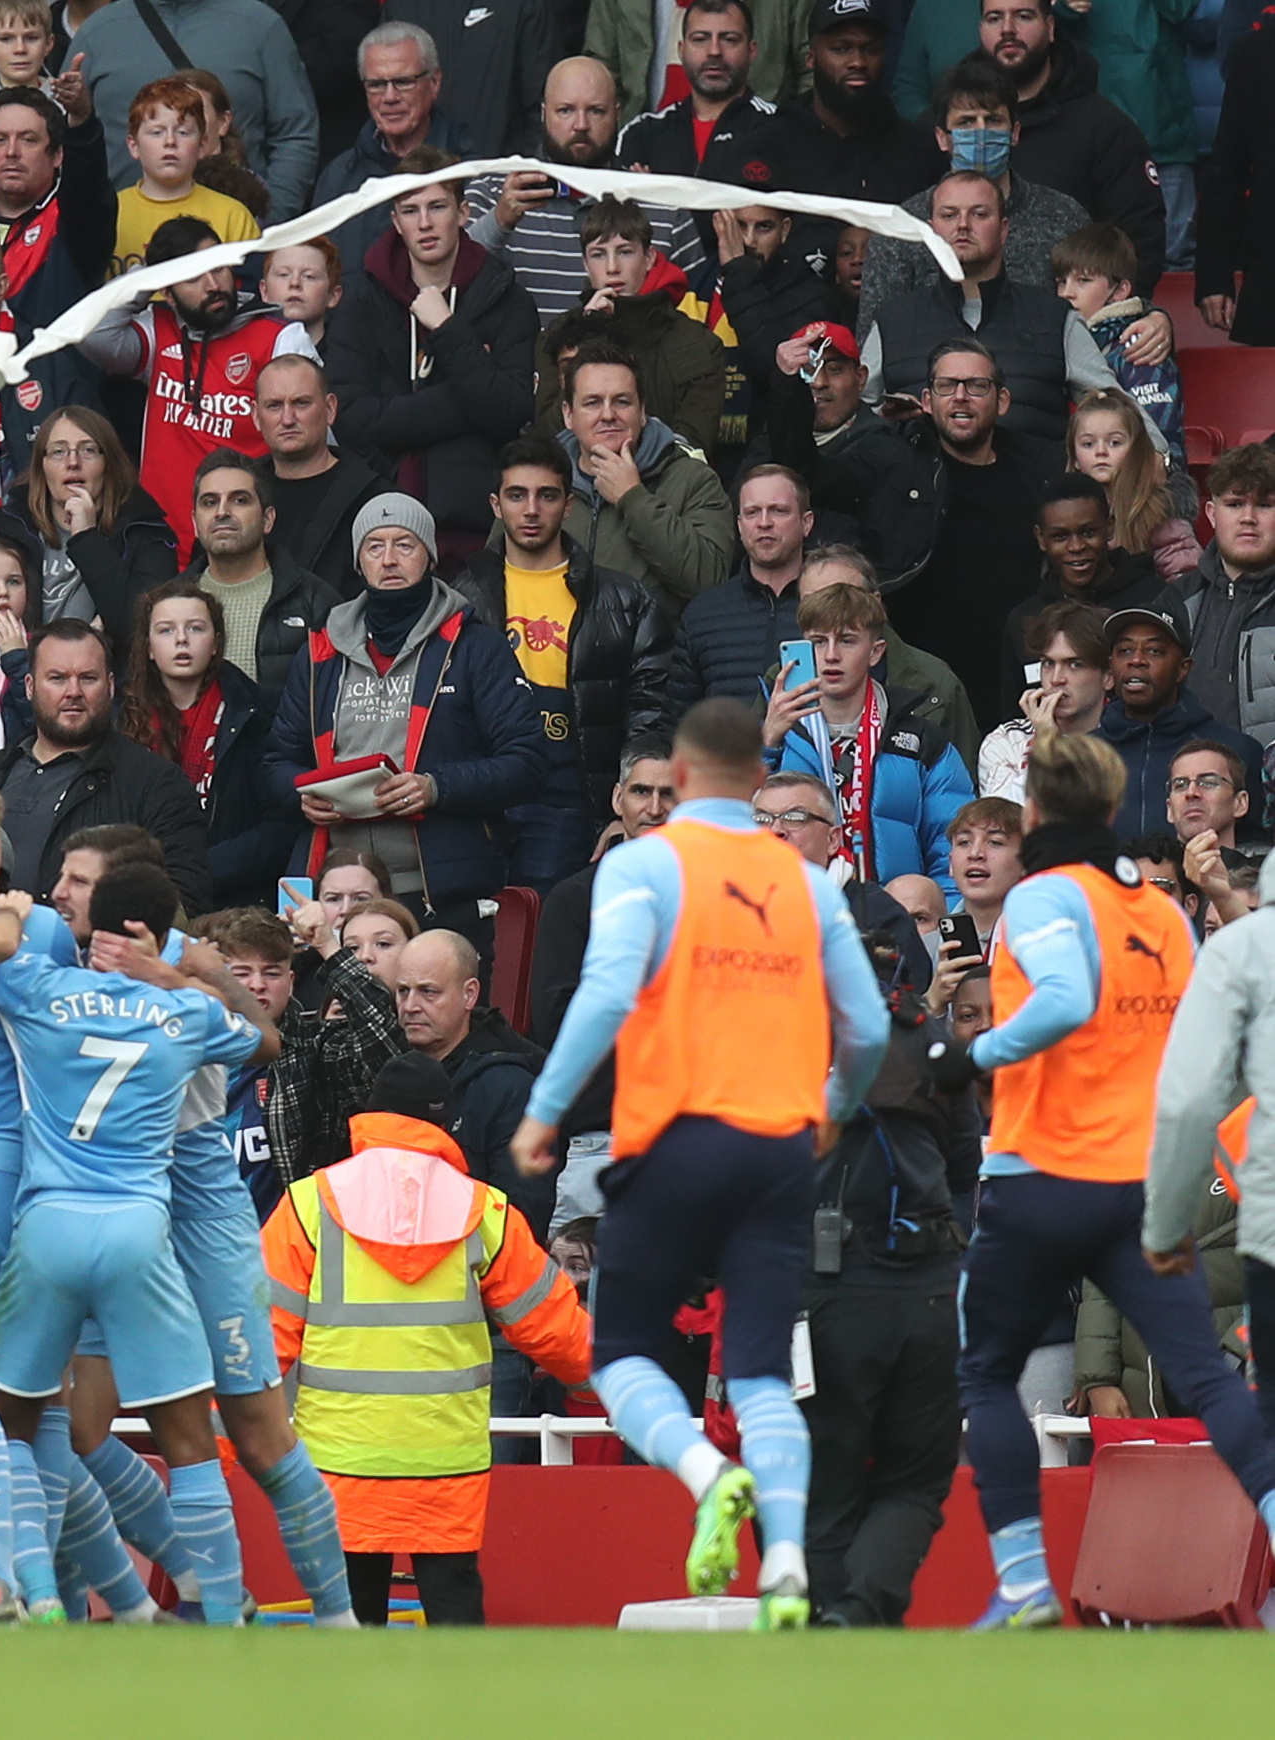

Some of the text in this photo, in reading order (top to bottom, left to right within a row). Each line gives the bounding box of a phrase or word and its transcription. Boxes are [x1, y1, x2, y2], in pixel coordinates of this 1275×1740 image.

[1130, 382, 1159, 397] VISIT
[49, 990, 185, 1039] STERLING
[67, 1035, 150, 1142] 7
[218, 1315, 252, 1365] 3
